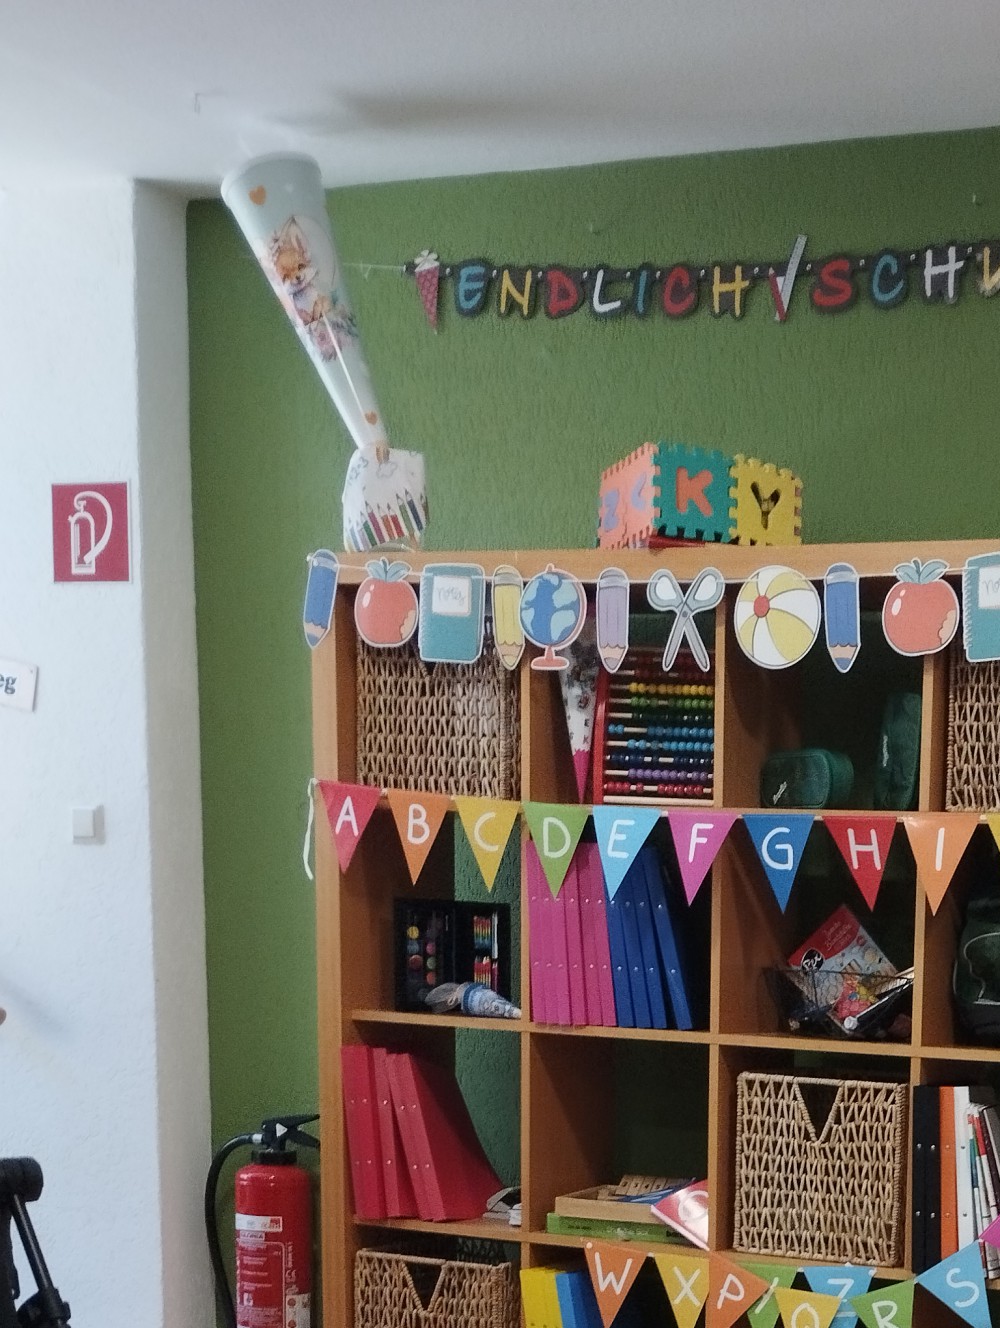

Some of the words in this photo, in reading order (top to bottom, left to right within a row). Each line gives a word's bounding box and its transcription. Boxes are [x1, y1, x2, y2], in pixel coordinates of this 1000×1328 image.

[456, 262, 752, 318] ENDLICH
[675, 465, 714, 518] K
[750, 480, 782, 531] Y
[334, 794, 359, 836] A
[406, 803, 430, 845] B
[473, 811, 499, 852] C
[542, 815, 571, 859] D
[607, 819, 635, 859] E
[688, 822, 715, 864] F
[760, 826, 795, 871] G
[847, 827, 882, 870] H
[934, 826, 946, 872] I
[593, 1251, 633, 1296] W
[672, 1265, 701, 1308] X
[716, 1272, 745, 1310] P
[945, 1266, 980, 1309] S
